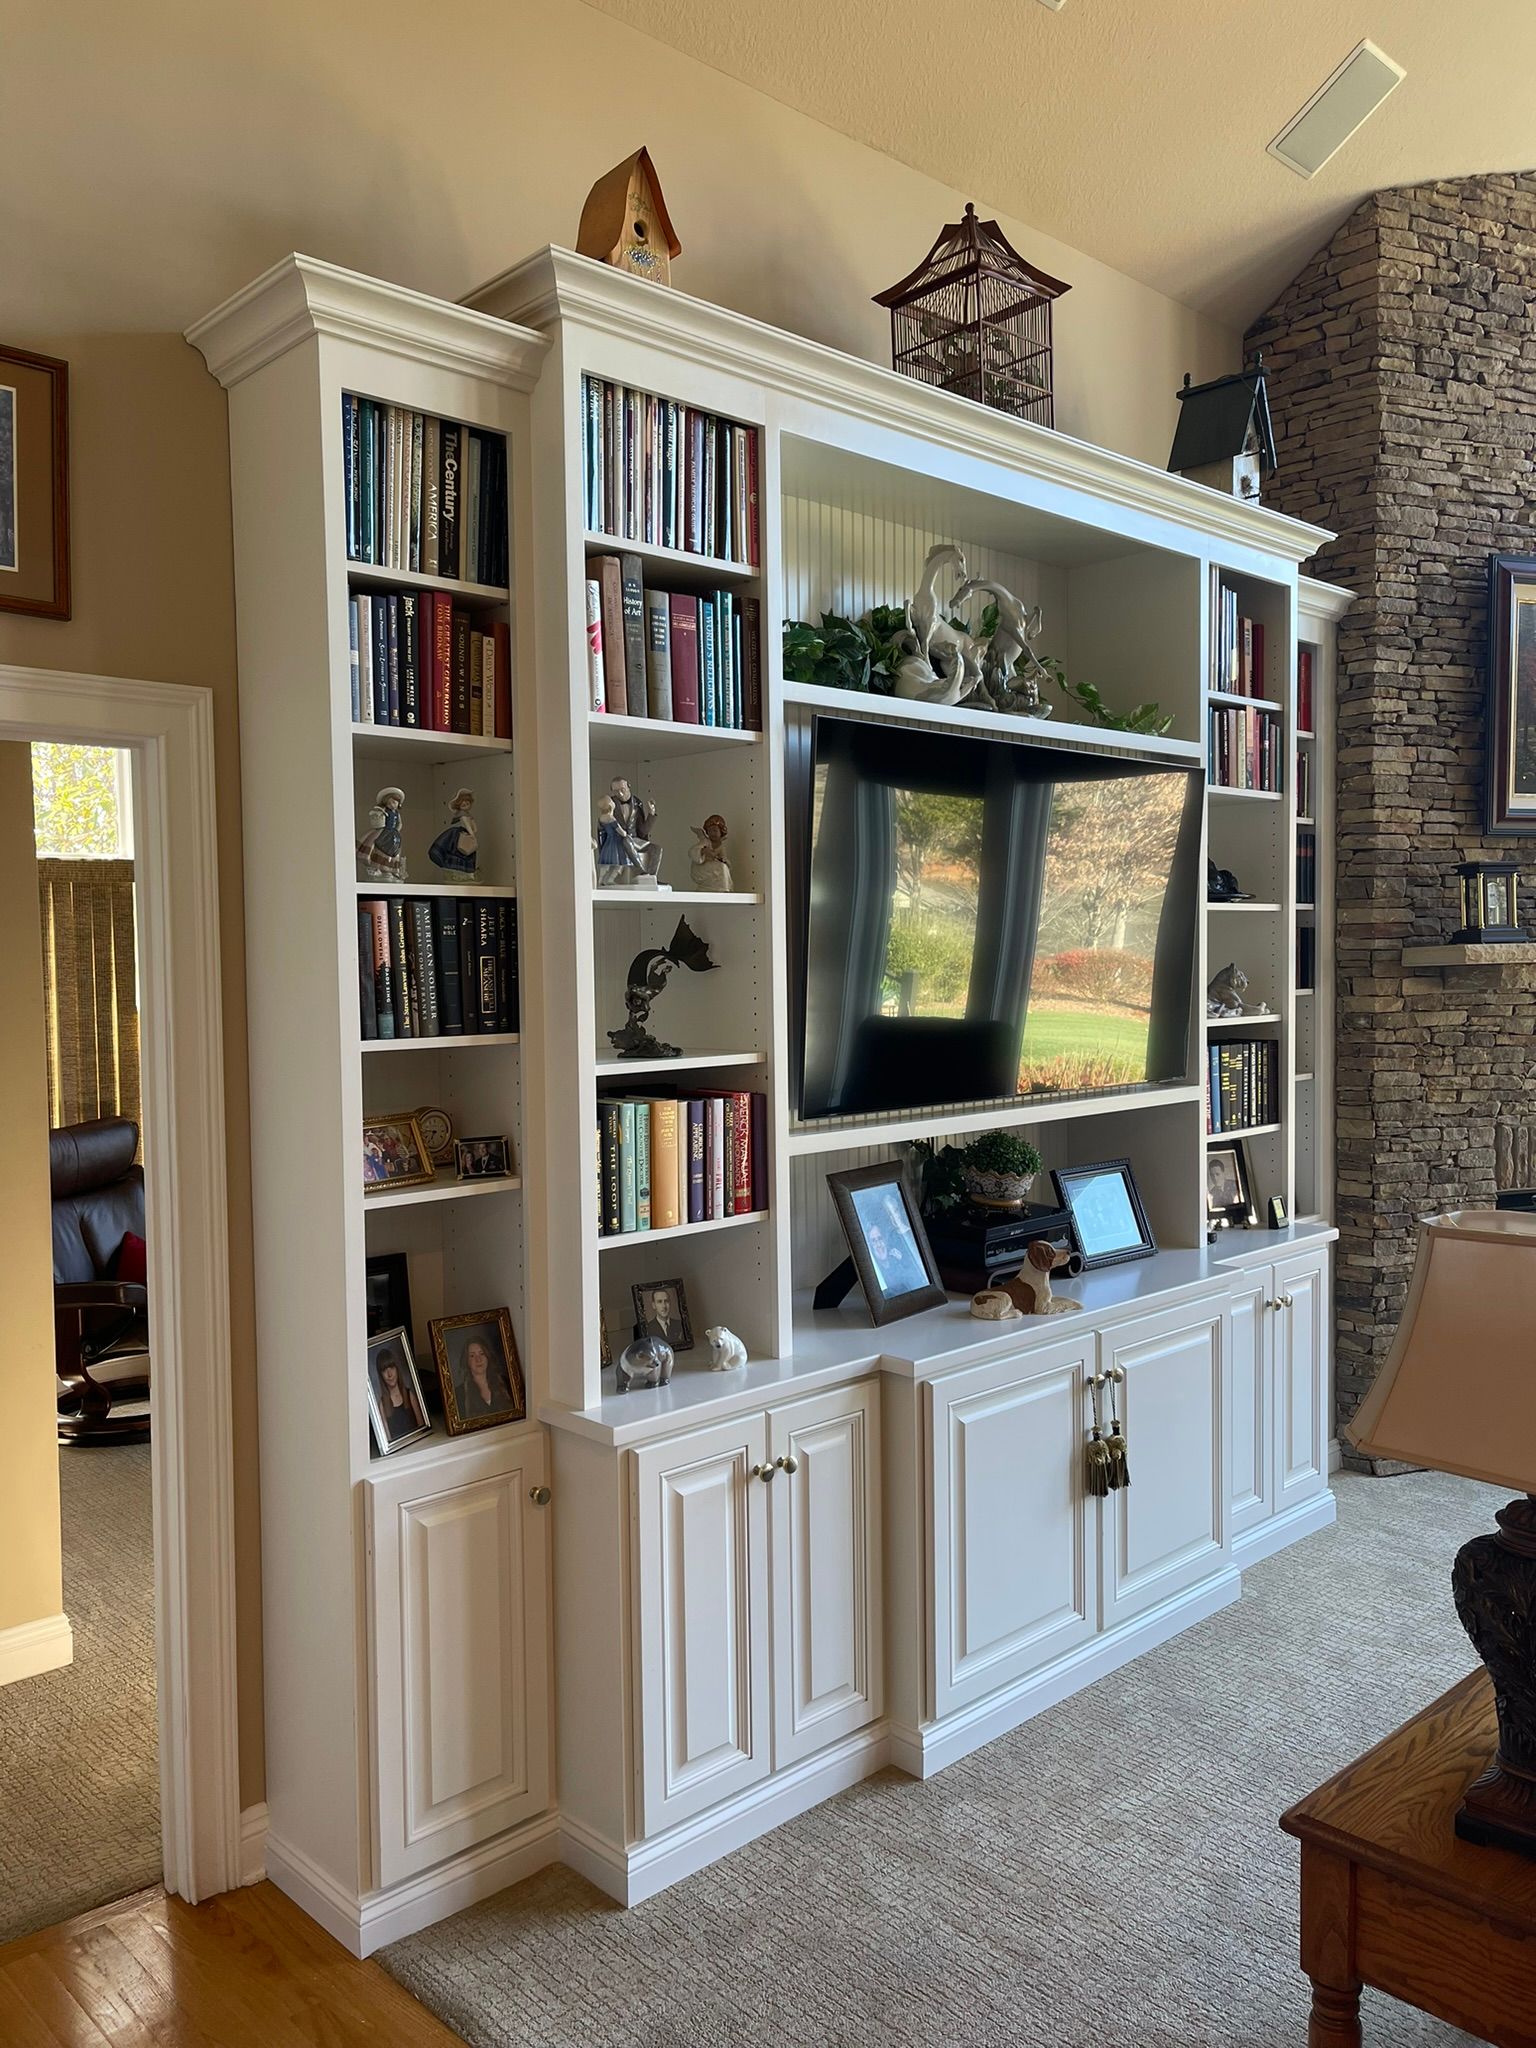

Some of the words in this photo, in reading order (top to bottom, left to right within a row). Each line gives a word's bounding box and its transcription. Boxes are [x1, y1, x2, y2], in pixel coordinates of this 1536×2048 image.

[427, 481, 437, 541] AMERICA
[402, 595, 415, 617] jack
[623, 597, 643, 609] History
[624, 606, 631, 615] of
[631, 608, 642, 616] Art
[423, 907, 434, 967] AMERICAN
[427, 971, 437, 1020] SOLDIER
